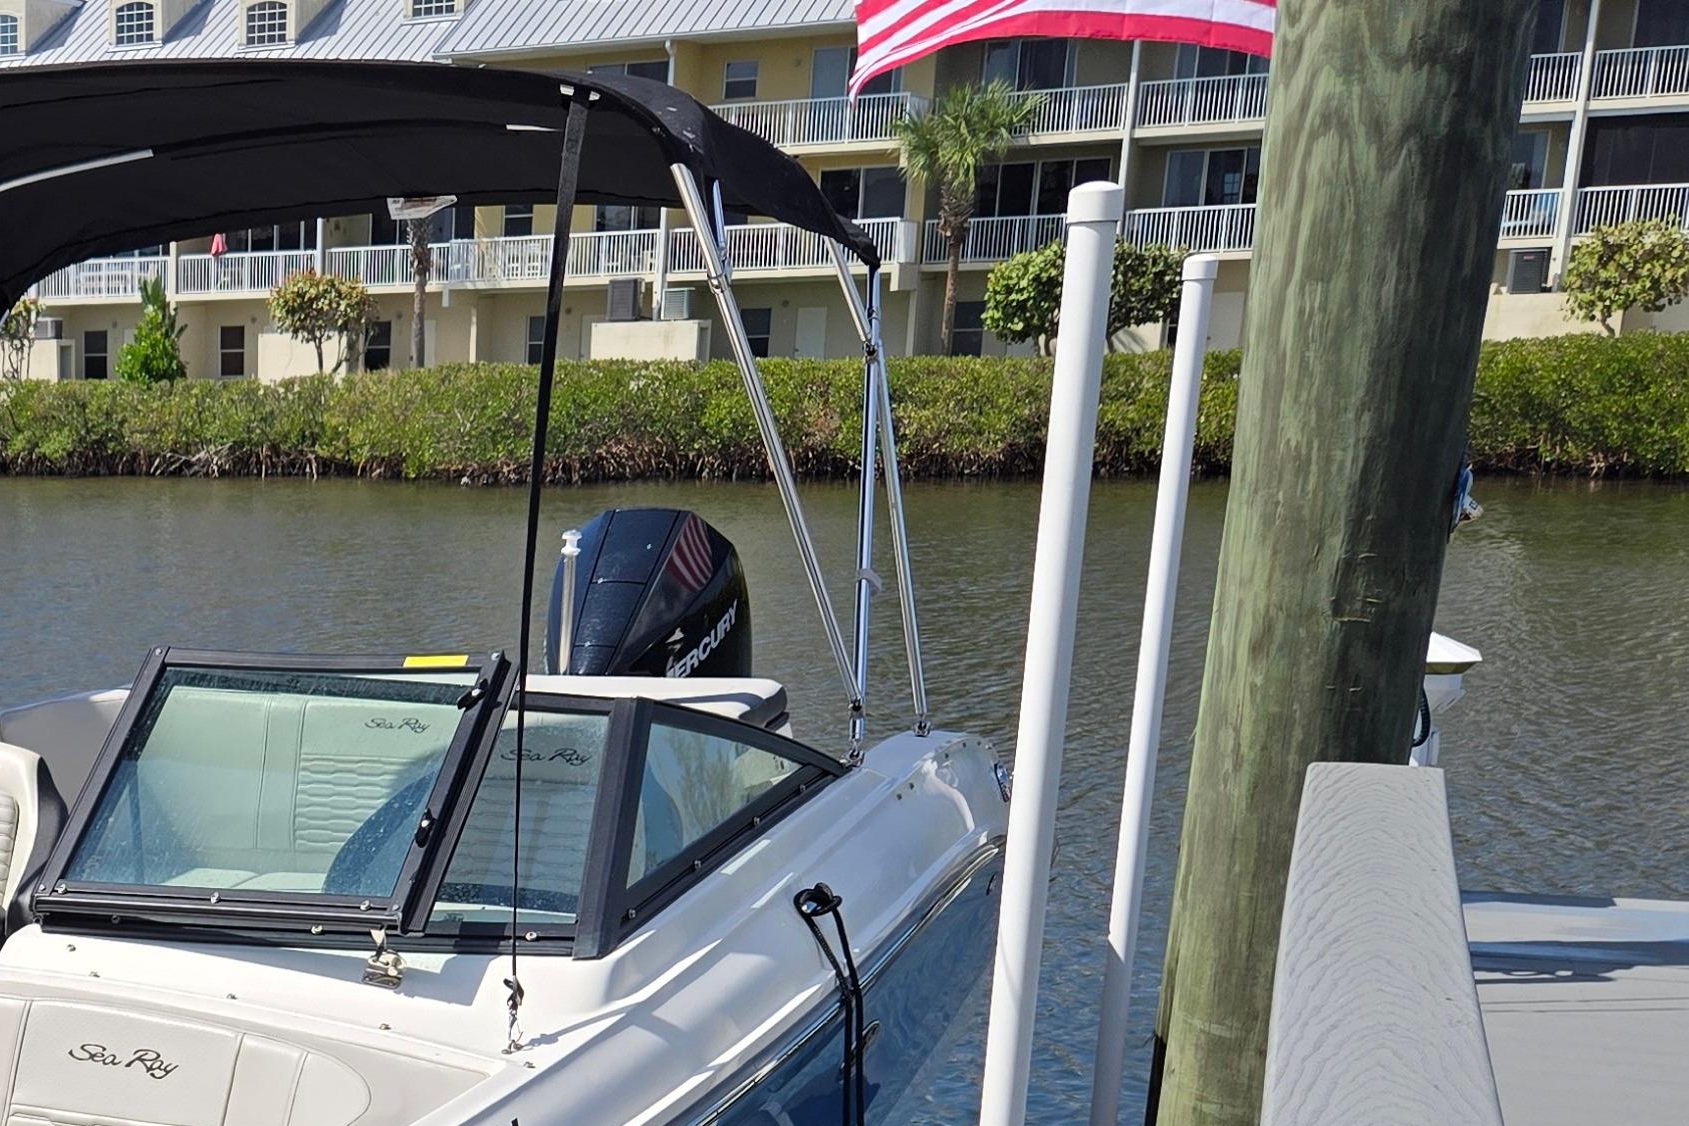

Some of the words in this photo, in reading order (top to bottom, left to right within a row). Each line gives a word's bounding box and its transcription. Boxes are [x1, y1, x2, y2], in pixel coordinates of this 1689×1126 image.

[364, 717, 397, 730] Sea
[398, 717, 431, 734] Ray
[548, 747, 594, 767] Ray
[68, 1043, 123, 1066] Sea
[124, 1048, 180, 1080] Ray
